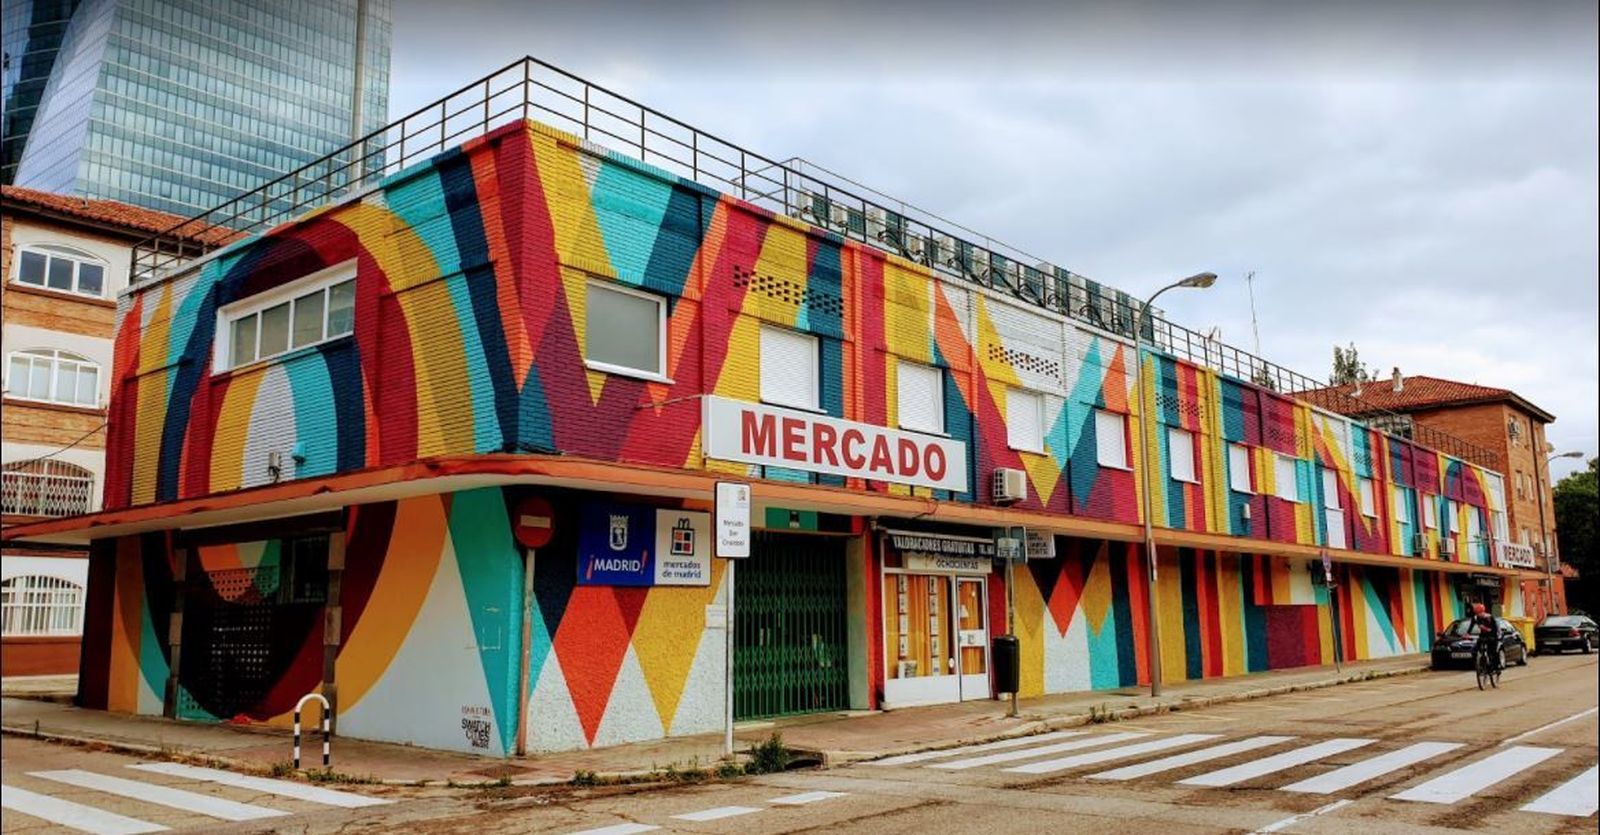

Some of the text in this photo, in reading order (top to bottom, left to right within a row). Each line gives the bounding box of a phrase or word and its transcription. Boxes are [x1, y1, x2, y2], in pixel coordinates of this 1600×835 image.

[741, 410, 946, 482] MERCADO
[893, 535, 941, 551] VALORACIONES
[942, 540, 975, 555] GRATUITAS
[1503, 544, 1532, 565] MERCADO
[662, 569, 701, 579] de madrid
[663, 560, 701, 569] mercados
